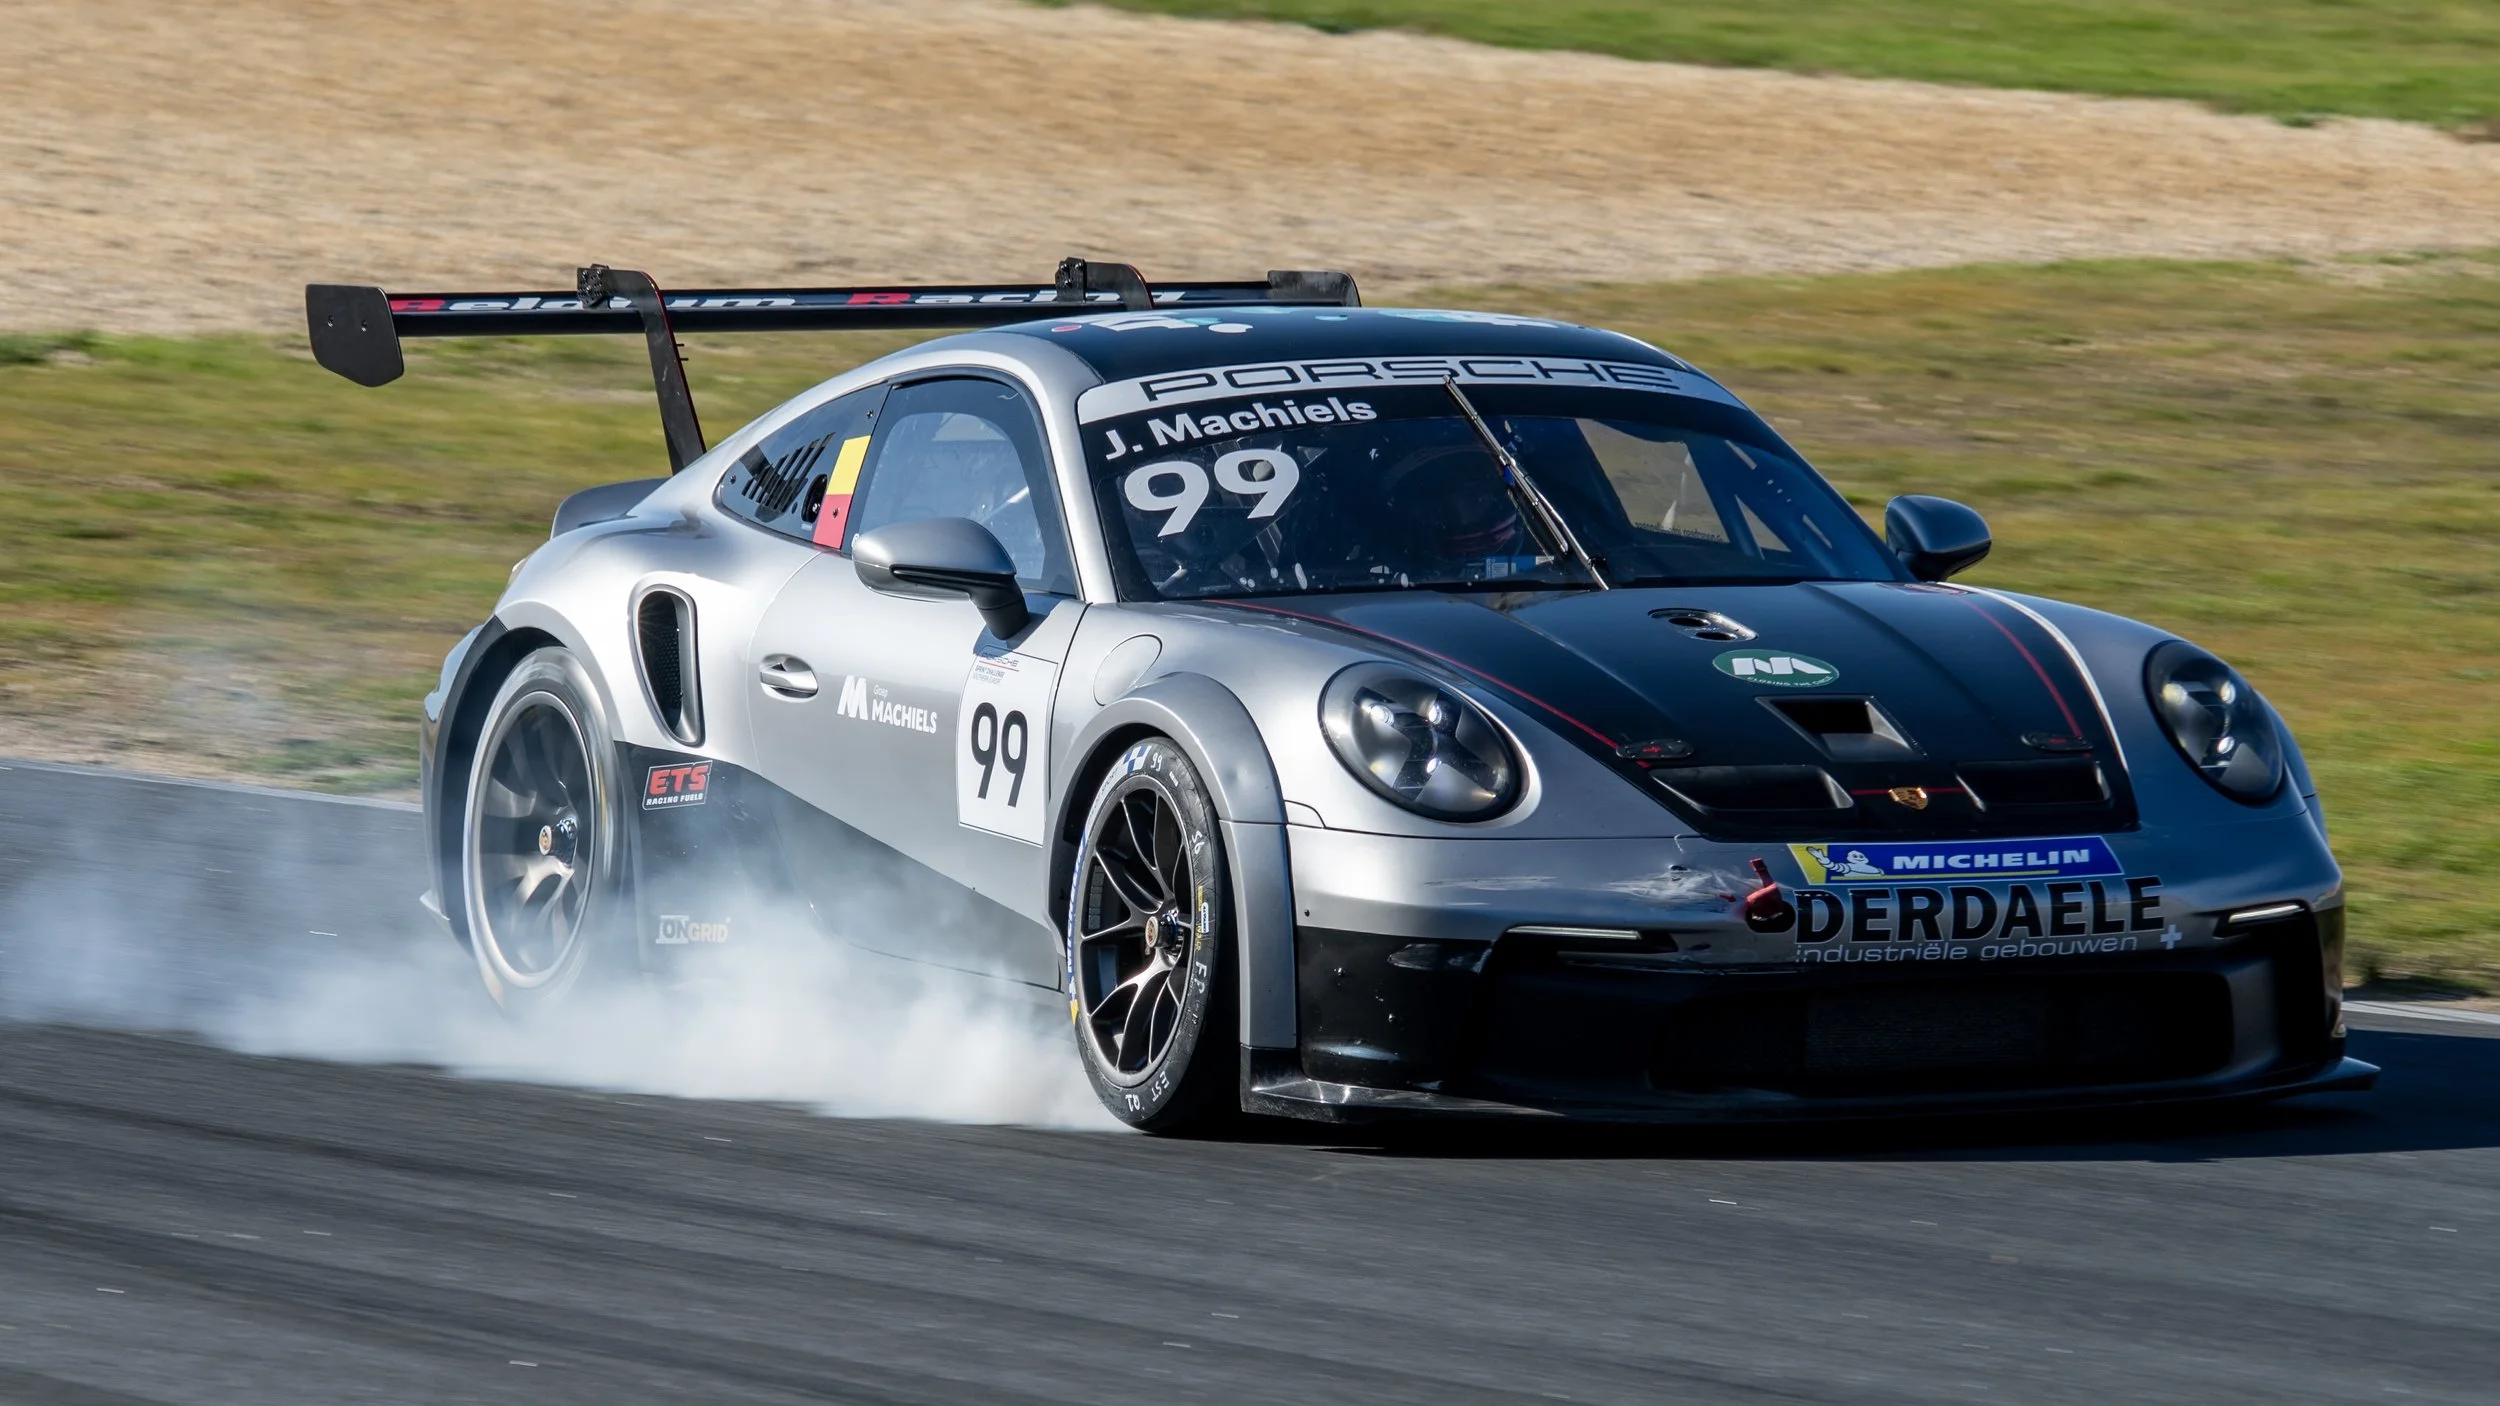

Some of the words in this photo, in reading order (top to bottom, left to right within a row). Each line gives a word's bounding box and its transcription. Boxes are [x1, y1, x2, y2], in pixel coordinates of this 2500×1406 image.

[1138, 359, 1680, 403] PORSCHE
[1106, 428, 1145, 460] J.
[1152, 397, 1379, 443] Machiels
[1123, 448, 1300, 537] 99
[872, 699, 937, 734] MACHIELS
[970, 701, 1028, 808] 99
[646, 796, 679, 806] RACING
[680, 793, 704, 804] FUELS
[649, 766, 708, 795] ETS
[1893, 849, 2090, 871] MICHELIN
[1794, 876, 2165, 944] DERDAELE
[1796, 942, 1968, 963] industriële
[1979, 936, 2138, 962] gebouwen
